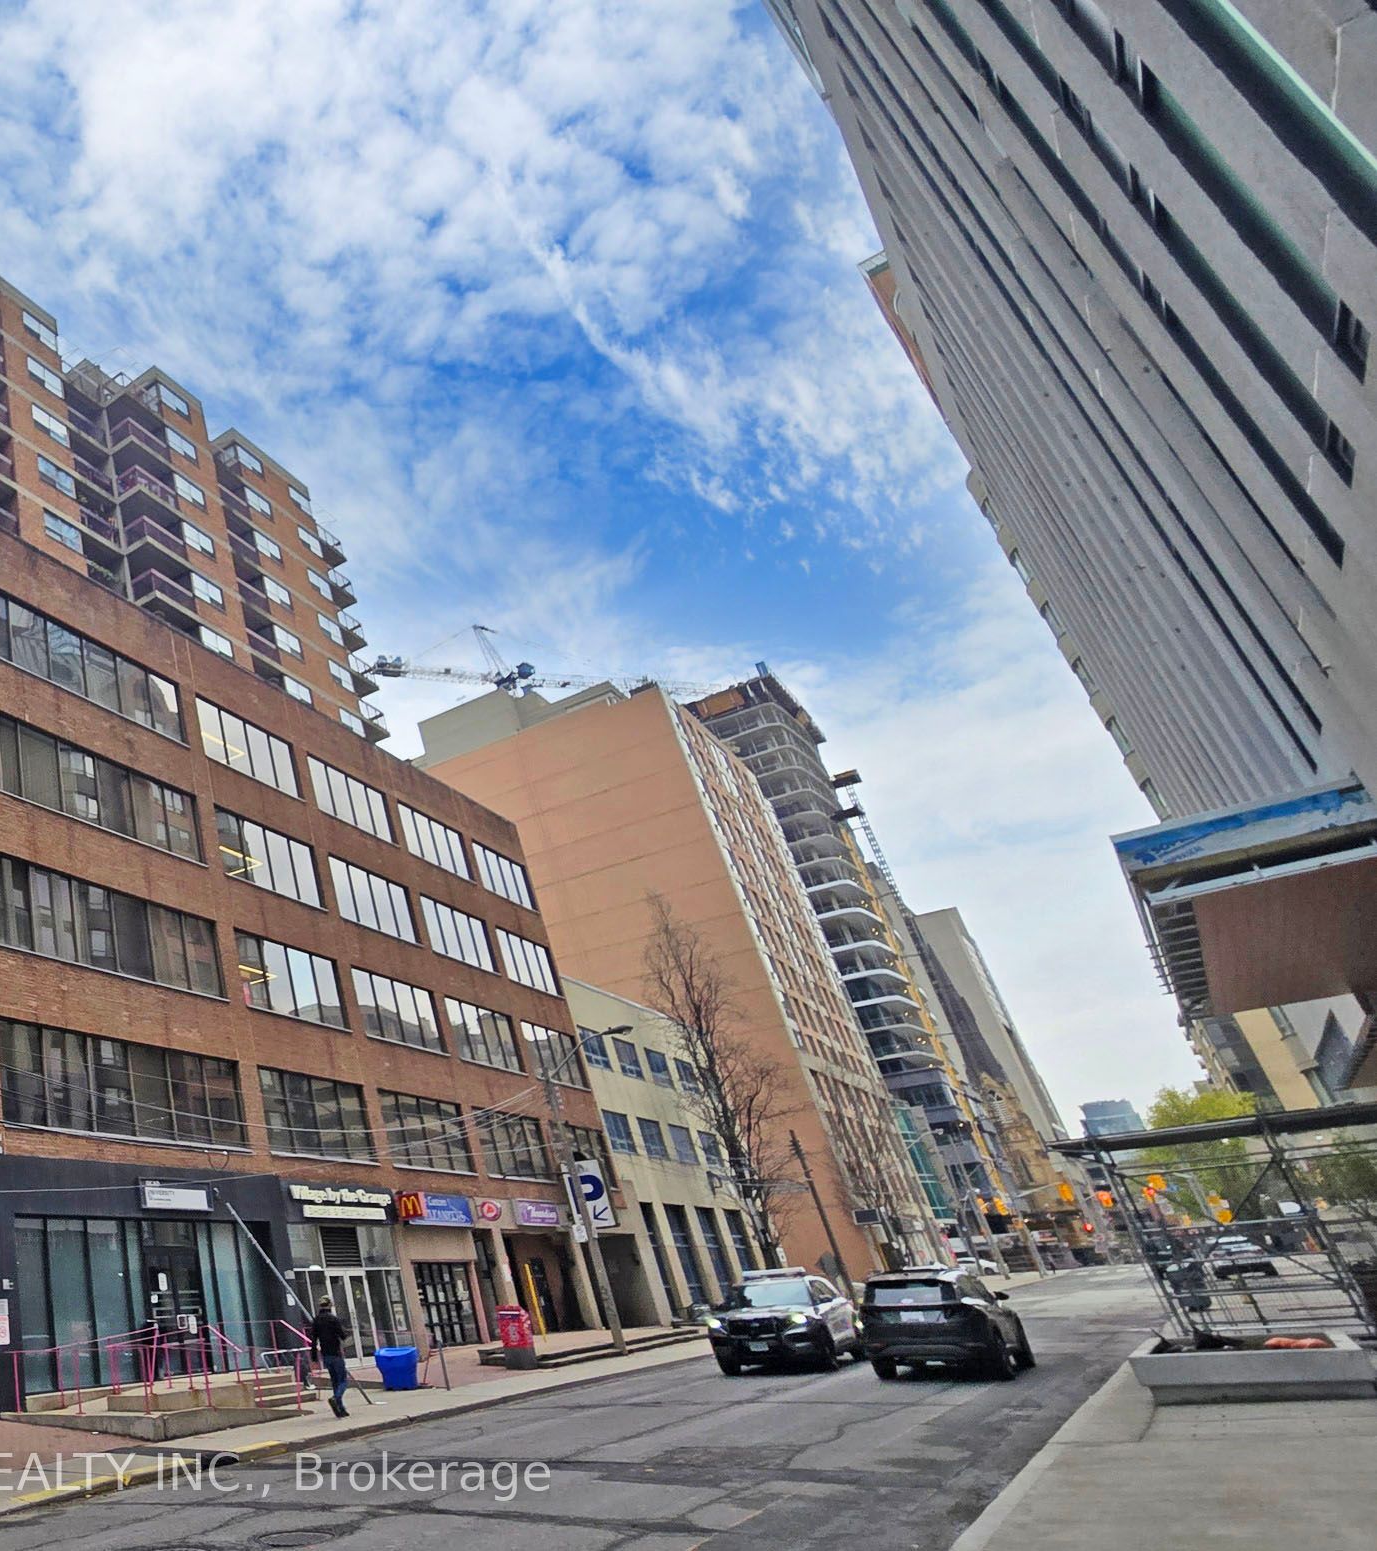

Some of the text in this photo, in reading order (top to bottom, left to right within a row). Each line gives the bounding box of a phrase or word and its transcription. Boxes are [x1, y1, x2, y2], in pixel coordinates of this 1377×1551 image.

[289, 1185, 392, 1207] Village by the Grange
